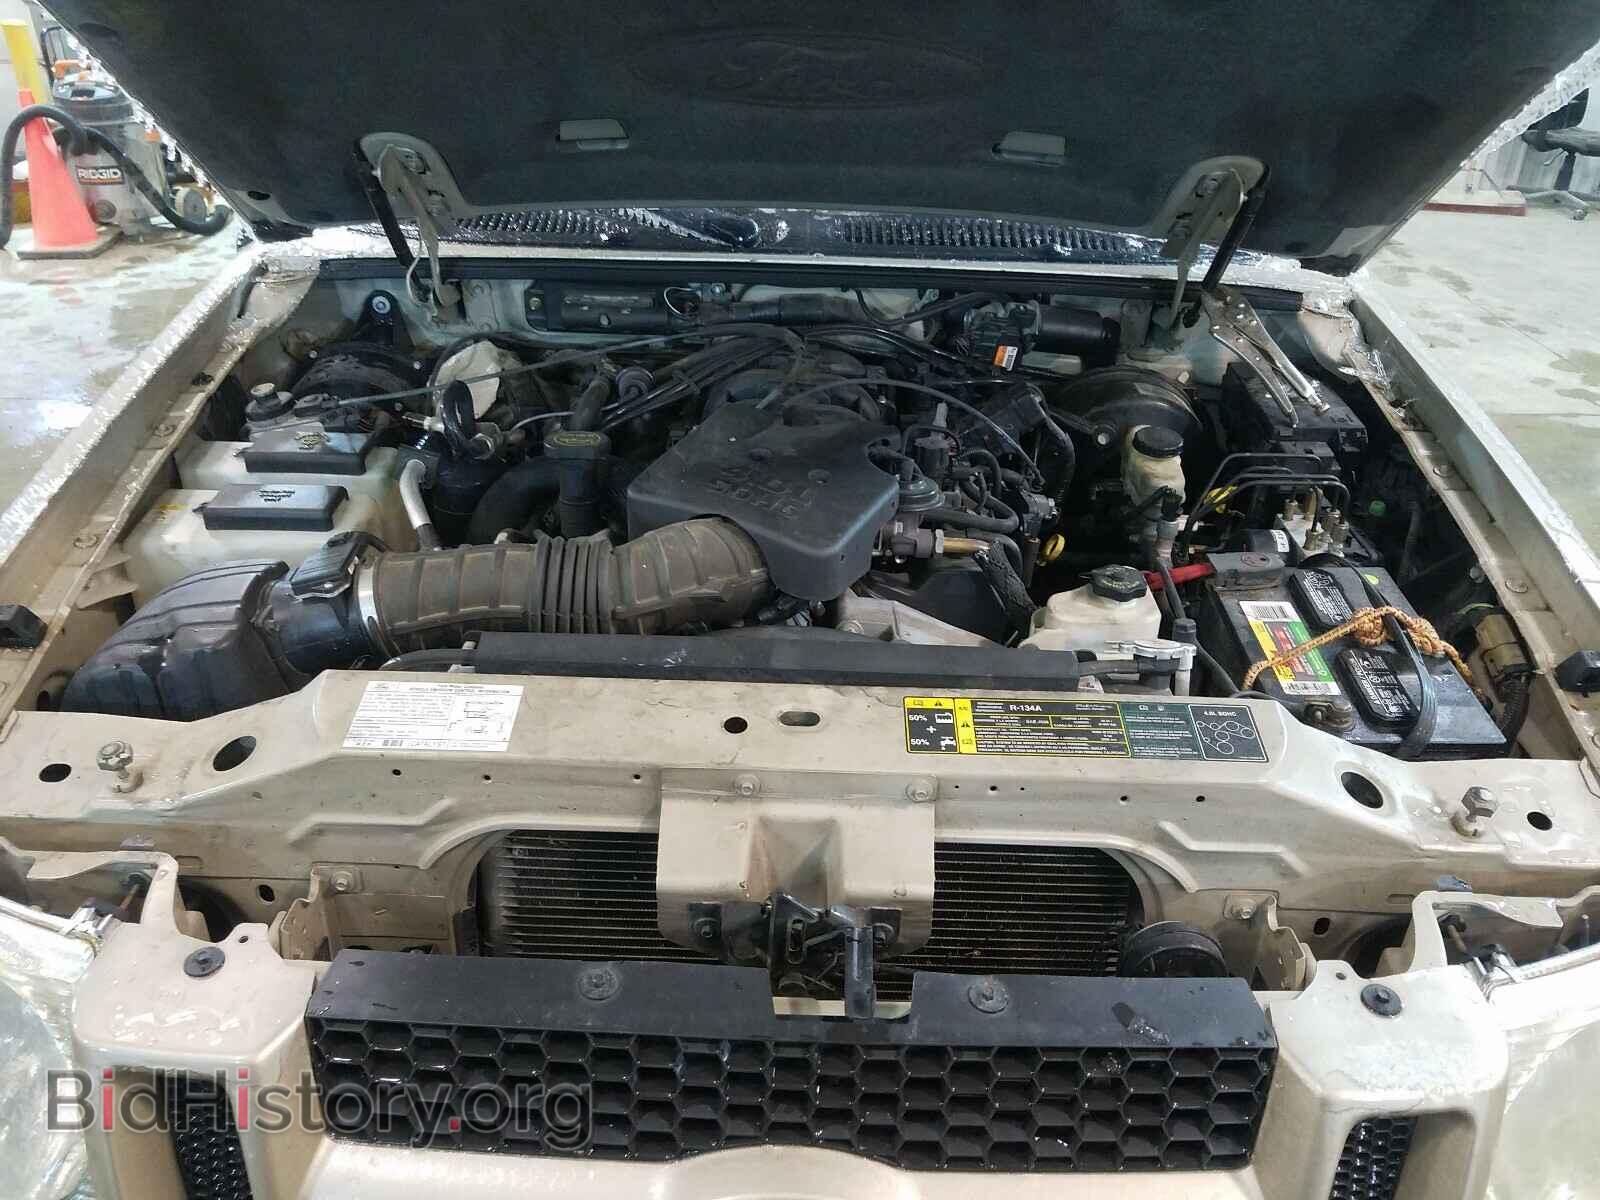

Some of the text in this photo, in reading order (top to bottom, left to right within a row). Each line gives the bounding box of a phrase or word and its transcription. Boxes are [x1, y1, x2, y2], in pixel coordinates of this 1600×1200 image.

[78, 168, 122, 179] RIDGID
[1009, 704, 1043, 712] R-134A
[908, 714, 928, 722] 50%
[910, 738, 930, 746] 50%
